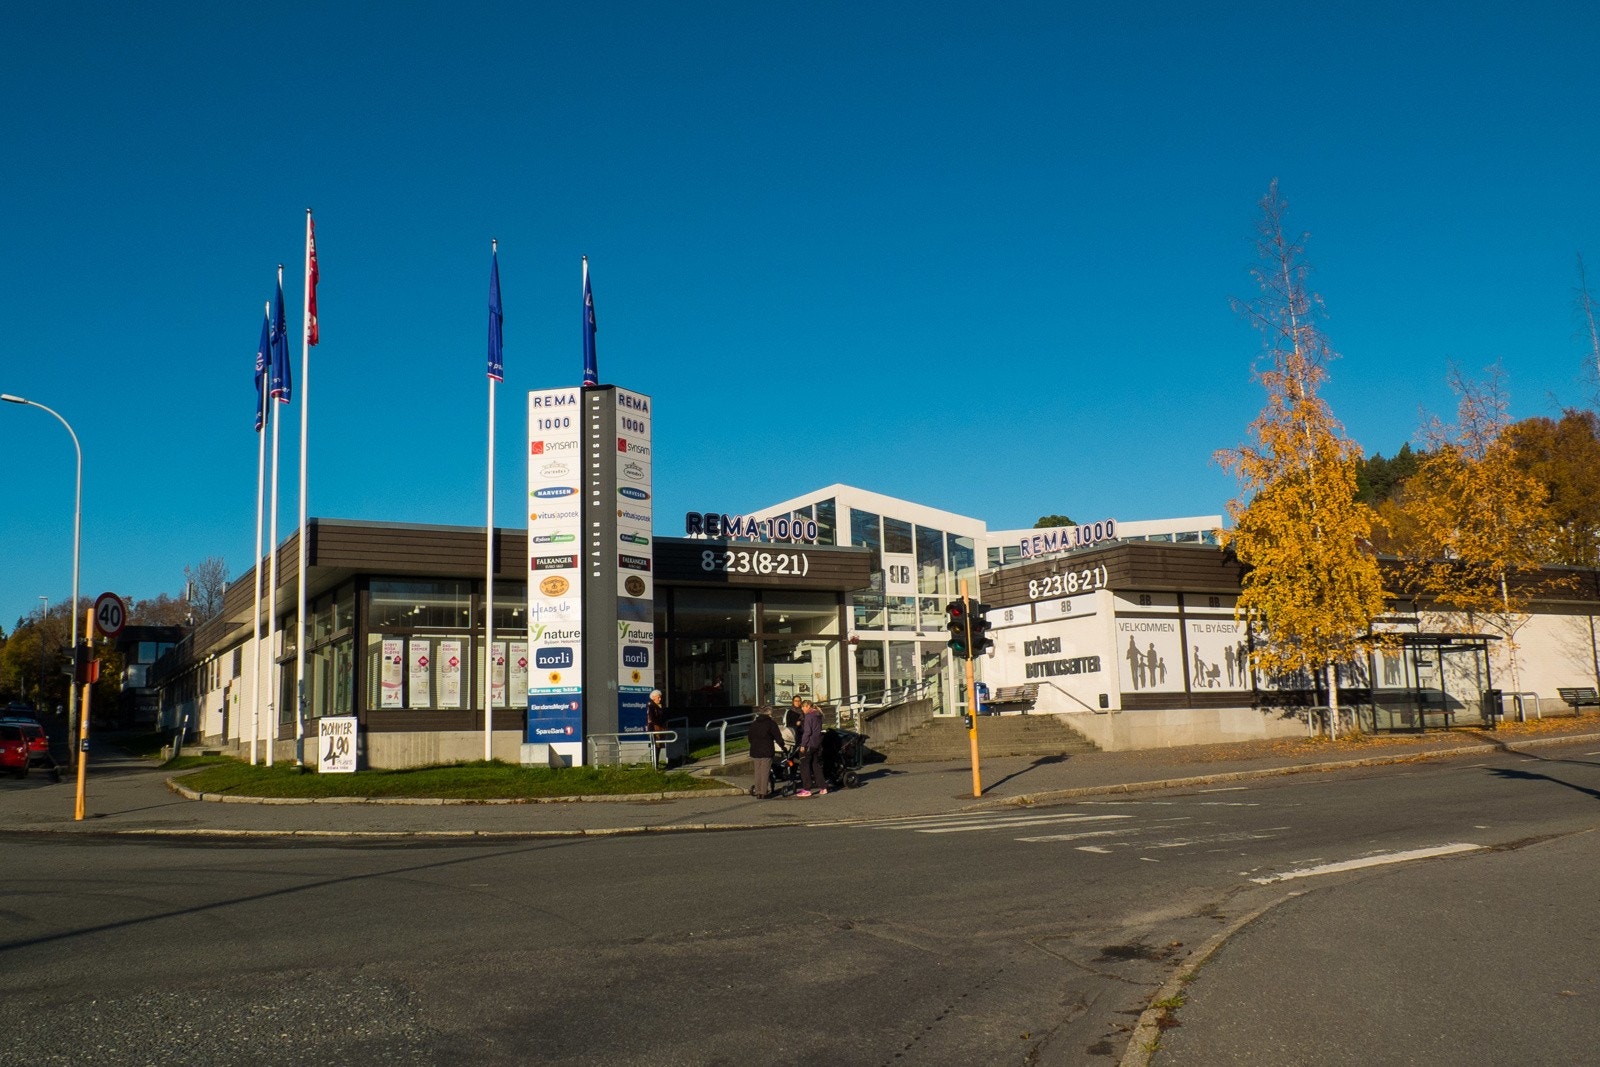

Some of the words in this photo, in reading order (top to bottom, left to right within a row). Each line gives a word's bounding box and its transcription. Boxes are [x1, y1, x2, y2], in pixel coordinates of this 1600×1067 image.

[534, 395, 576, 407] REMA
[618, 394, 649, 413] REMA
[538, 417, 570, 430] 1000
[621, 417, 645, 433] 1000
[686, 511, 759, 538] REMA
[766, 518, 818, 541] 1000
[1020, 529, 1070, 558] REMA
[1074, 517, 1118, 546] 1000
[536, 556, 573, 565] FALKANGER
[622, 557, 647, 566] FALKANGER
[99, 603, 120, 627] 40
[532, 602, 557, 621] HEADS
[559, 601, 571, 612] UP
[1118, 622, 1175, 632] VELKOMMEN
[1192, 624, 1204, 633] TIL
[1206, 623, 1238, 634] BYÅSEN
[1023, 636, 1062, 657] BYÅSEN
[539, 652, 570, 664] norli
[625, 653, 647, 663] norli
[1025, 656, 1102, 679] BUTIKKSENTER
